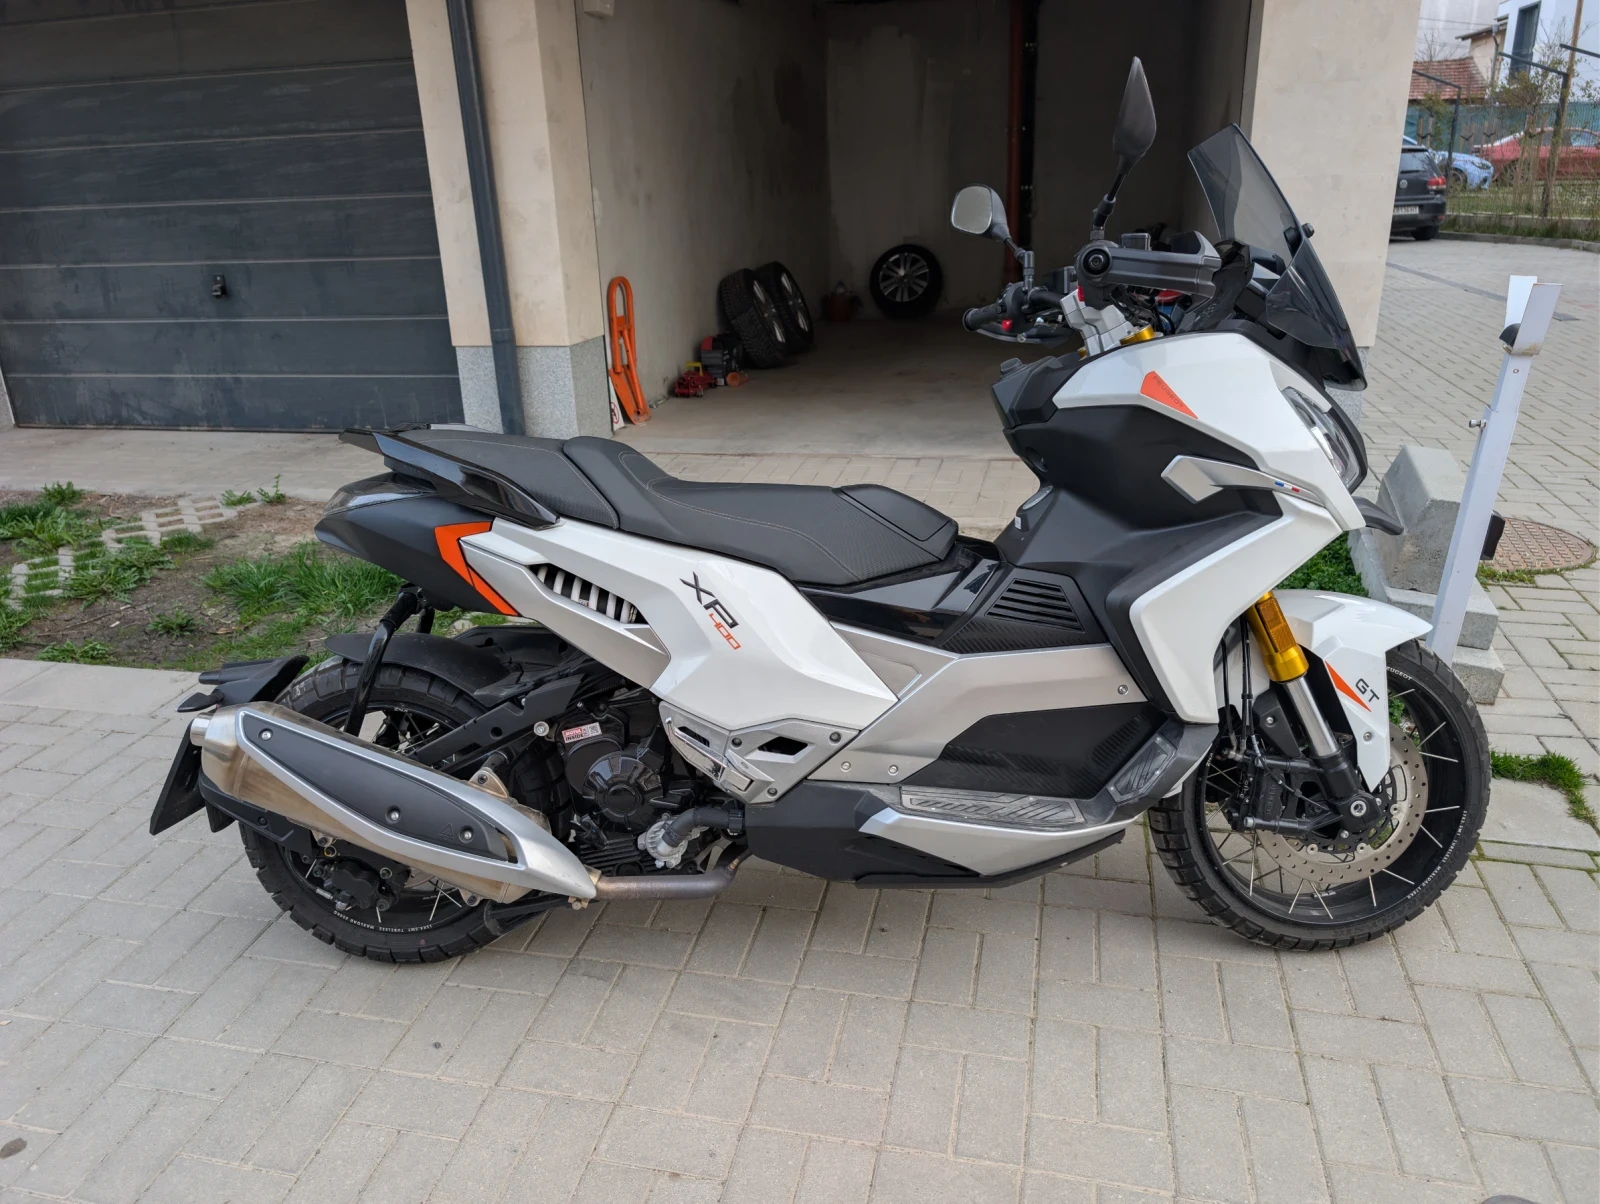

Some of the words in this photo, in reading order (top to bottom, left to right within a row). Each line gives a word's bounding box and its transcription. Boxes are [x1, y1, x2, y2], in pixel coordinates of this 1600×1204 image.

[1153, 375, 1184, 408] PEUGEOT
[679, 571, 739, 629] XP
[708, 612, 741, 650] 400
[1386, 665, 1412, 681] EUGEOT
[1355, 678, 1380, 702] GT
[565, 728, 582, 736] MOTUL
[1442, 839, 1458, 863] TUBELESS
[1422, 865, 1441, 887] MAXLOAD
[350, 918, 375, 930] MAXLOAD
